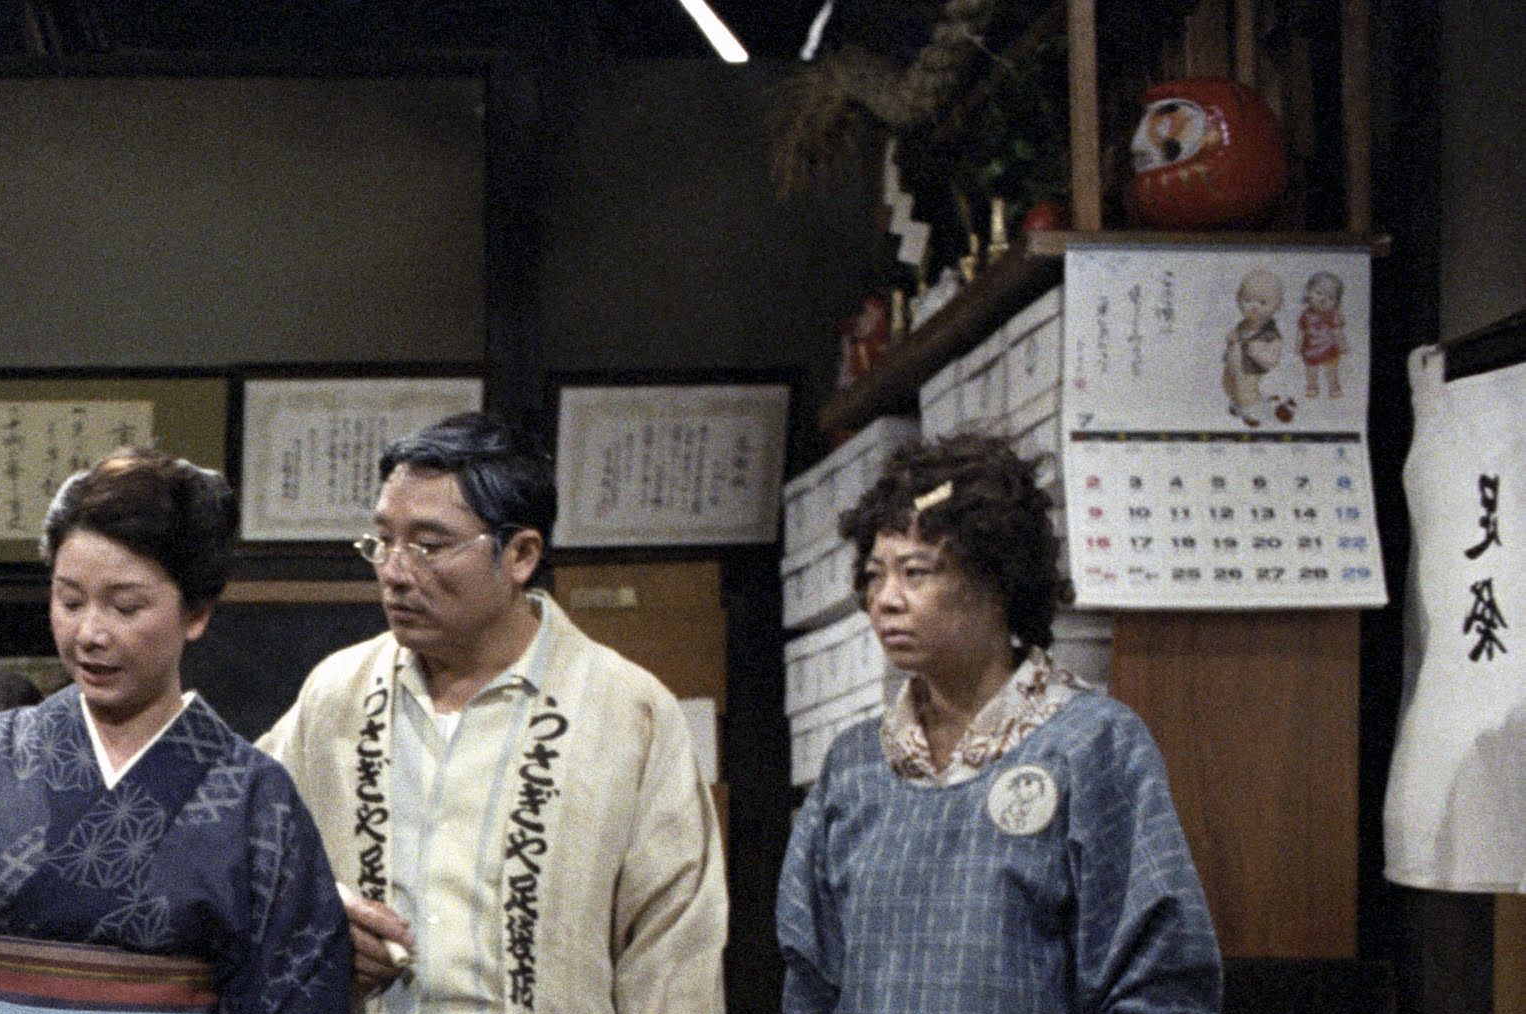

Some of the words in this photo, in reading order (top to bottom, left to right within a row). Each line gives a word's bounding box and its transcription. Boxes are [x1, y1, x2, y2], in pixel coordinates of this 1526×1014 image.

[1086, 474, 1100, 489] 2
[1130, 475, 1142, 490] 3
[1170, 475, 1183, 489] 4
[1211, 475, 1225, 490] 5
[1253, 475, 1267, 489] 6
[1296, 475, 1310, 489] 7
[1088, 506, 1103, 520] 9
[1128, 506, 1152, 520] 10
[1171, 506, 1190, 520] 11
[1209, 506, 1235, 520] 12
[1251, 506, 1275, 520] 13
[1294, 506, 1317, 519] 14
[1335, 506, 1360, 520] 15
[1086, 536, 1111, 549] 16
[1130, 536, 1153, 549] 17
[1171, 536, 1196, 549] 18
[1213, 536, 1238, 549] 19
[1252, 536, 1282, 550] 20
[1298, 536, 1322, 550] 21
[1338, 536, 1367, 550] 22
[1172, 567, 1201, 581] 25
[1214, 567, 1243, 581] 26
[1256, 567, 1285, 581] 27
[1299, 567, 1329, 581] 28
[1342, 567, 1371, 581] 29
